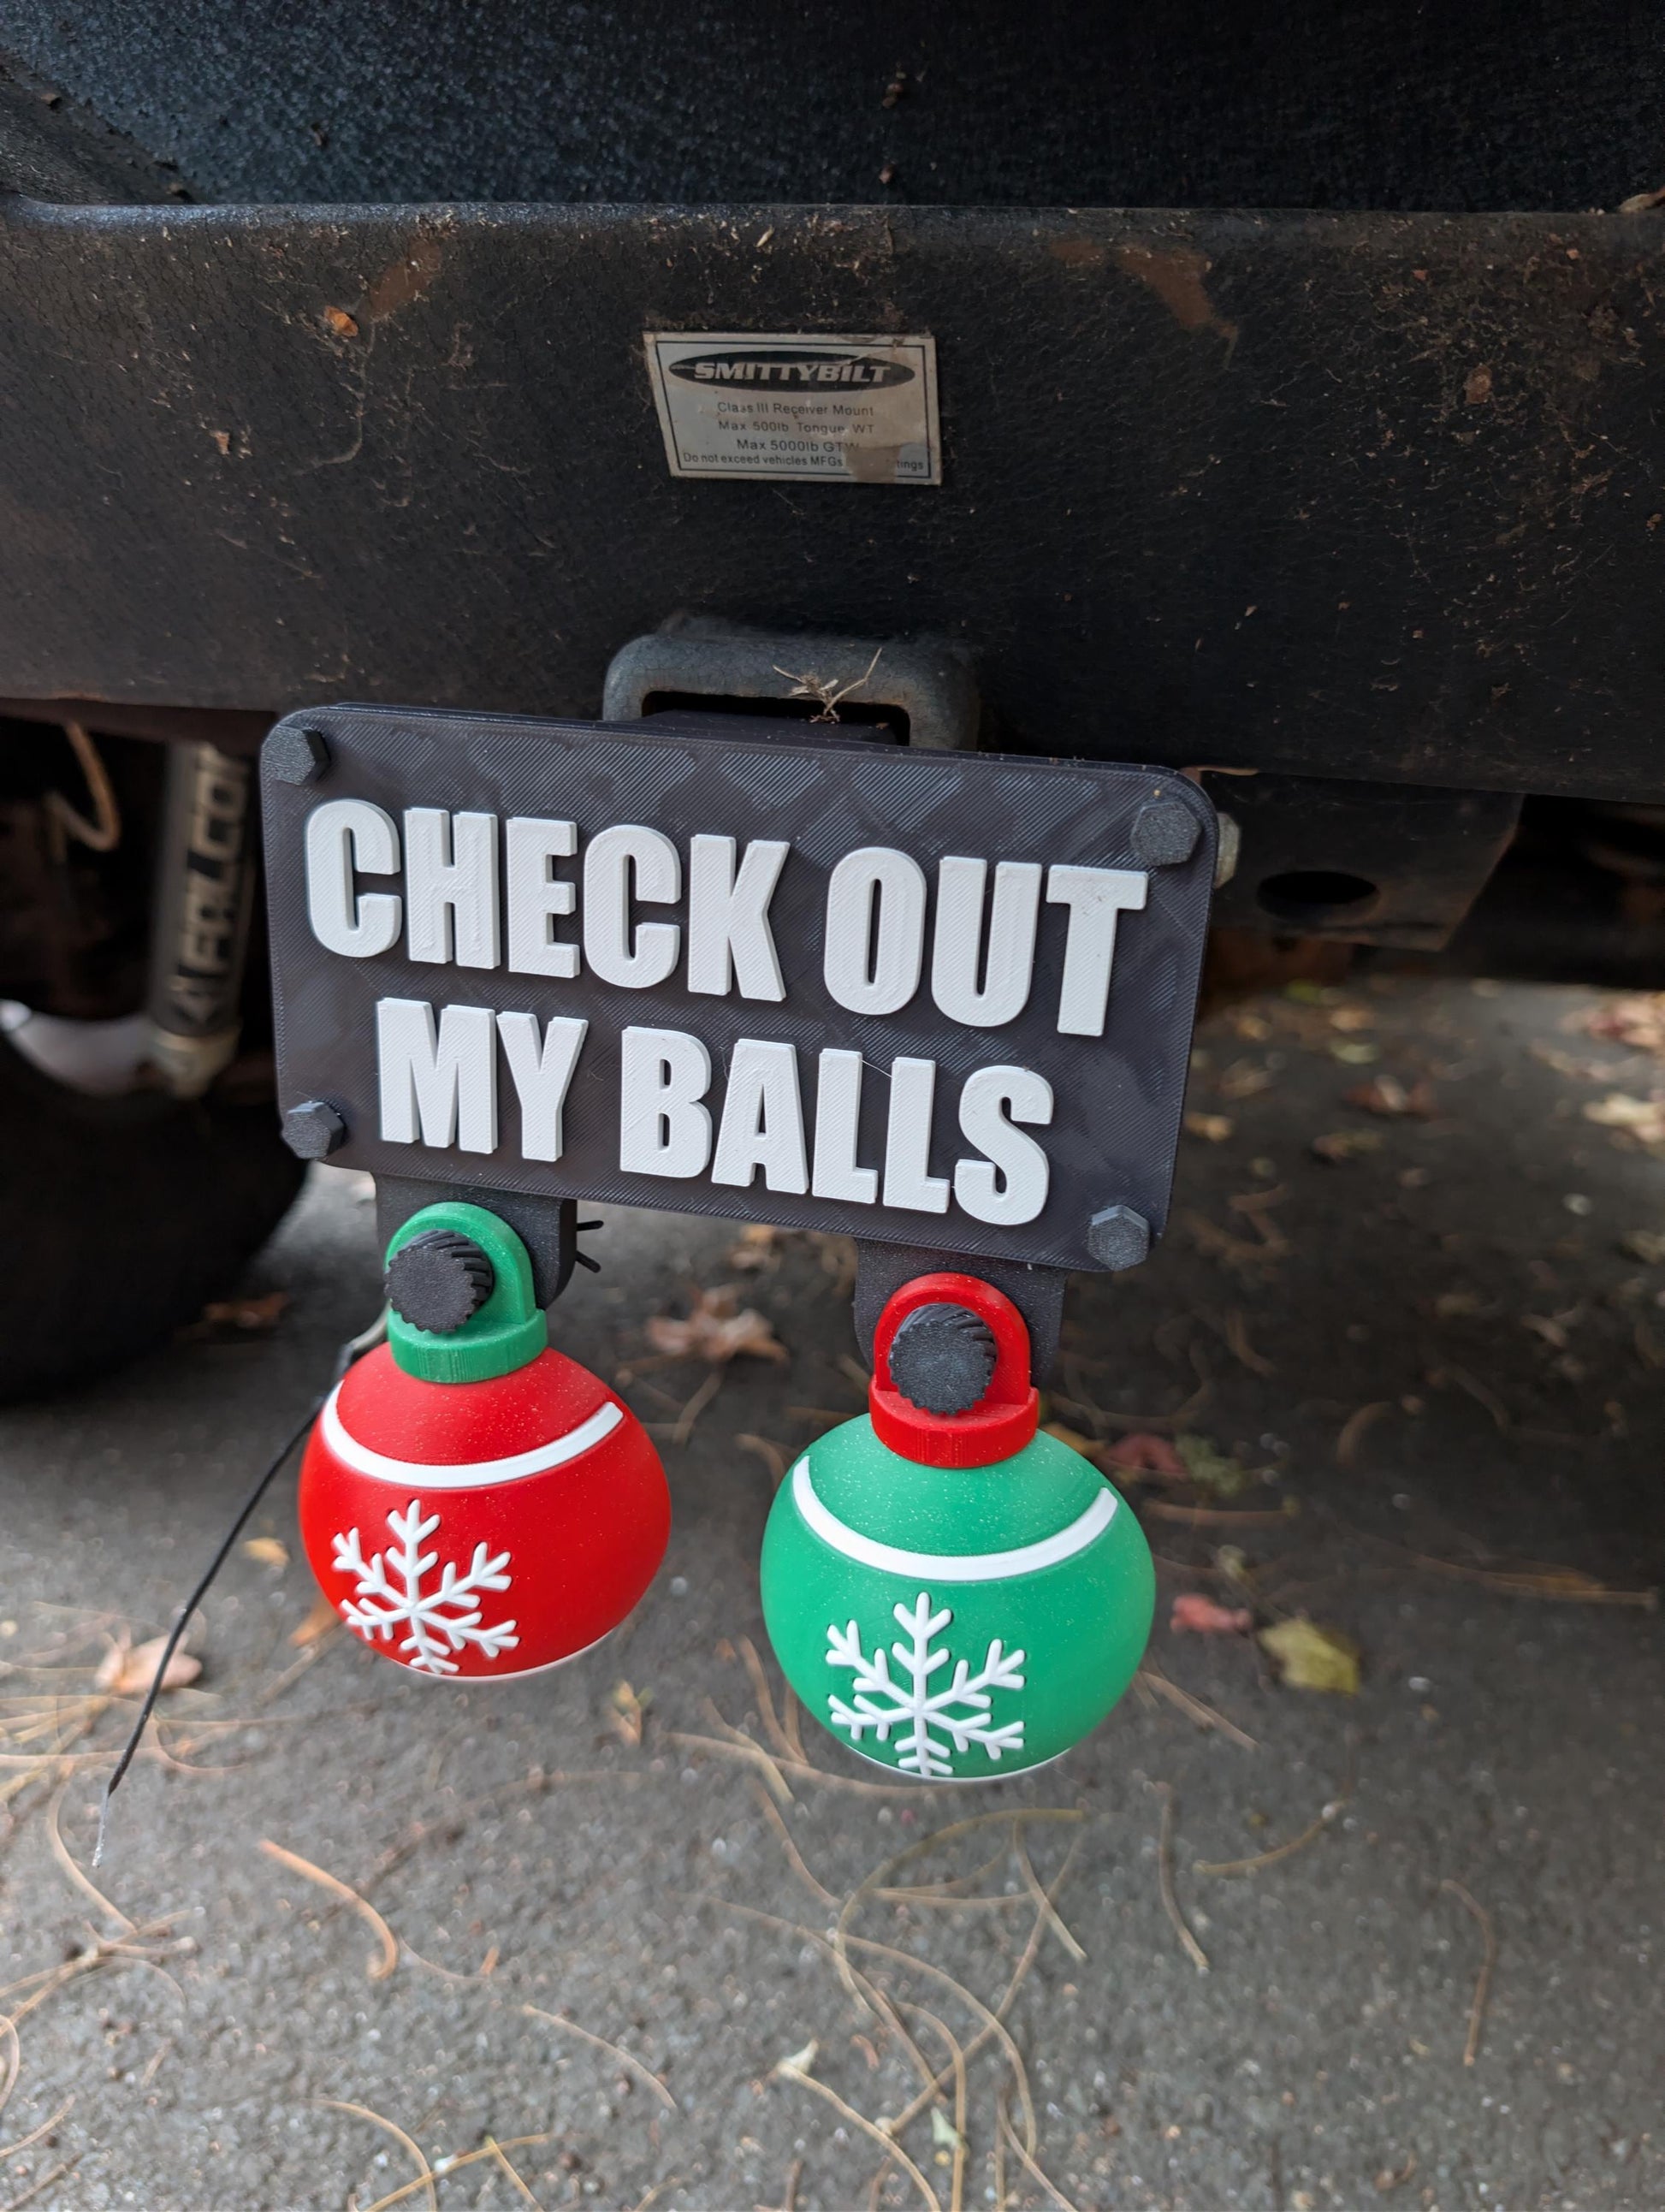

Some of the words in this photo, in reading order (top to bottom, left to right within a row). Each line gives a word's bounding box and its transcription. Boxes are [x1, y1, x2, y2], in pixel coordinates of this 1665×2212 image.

[694, 362, 891, 383] SMITTYBILT
[773, 403, 827, 414] Receiver
[833, 405, 874, 416] Mount
[719, 421, 747, 430] Max
[752, 422, 789, 432] 500lb
[797, 423, 845, 436] Tongue
[852, 424, 874, 433] WT
[737, 439, 767, 450] Max
[770, 440, 819, 452] 5000lb
[684, 453, 699, 463] Do
[702, 454, 719, 464] not
[721, 454, 760, 465] exceed
[762, 455, 808, 466] vehicles
[810, 456, 844, 467] MFGs
[305, 798, 791, 1002] CHECK
[823, 846, 1148, 1037] OUT
[376, 997, 589, 1162] MY
[619, 1026, 1053, 1225] BALLS
